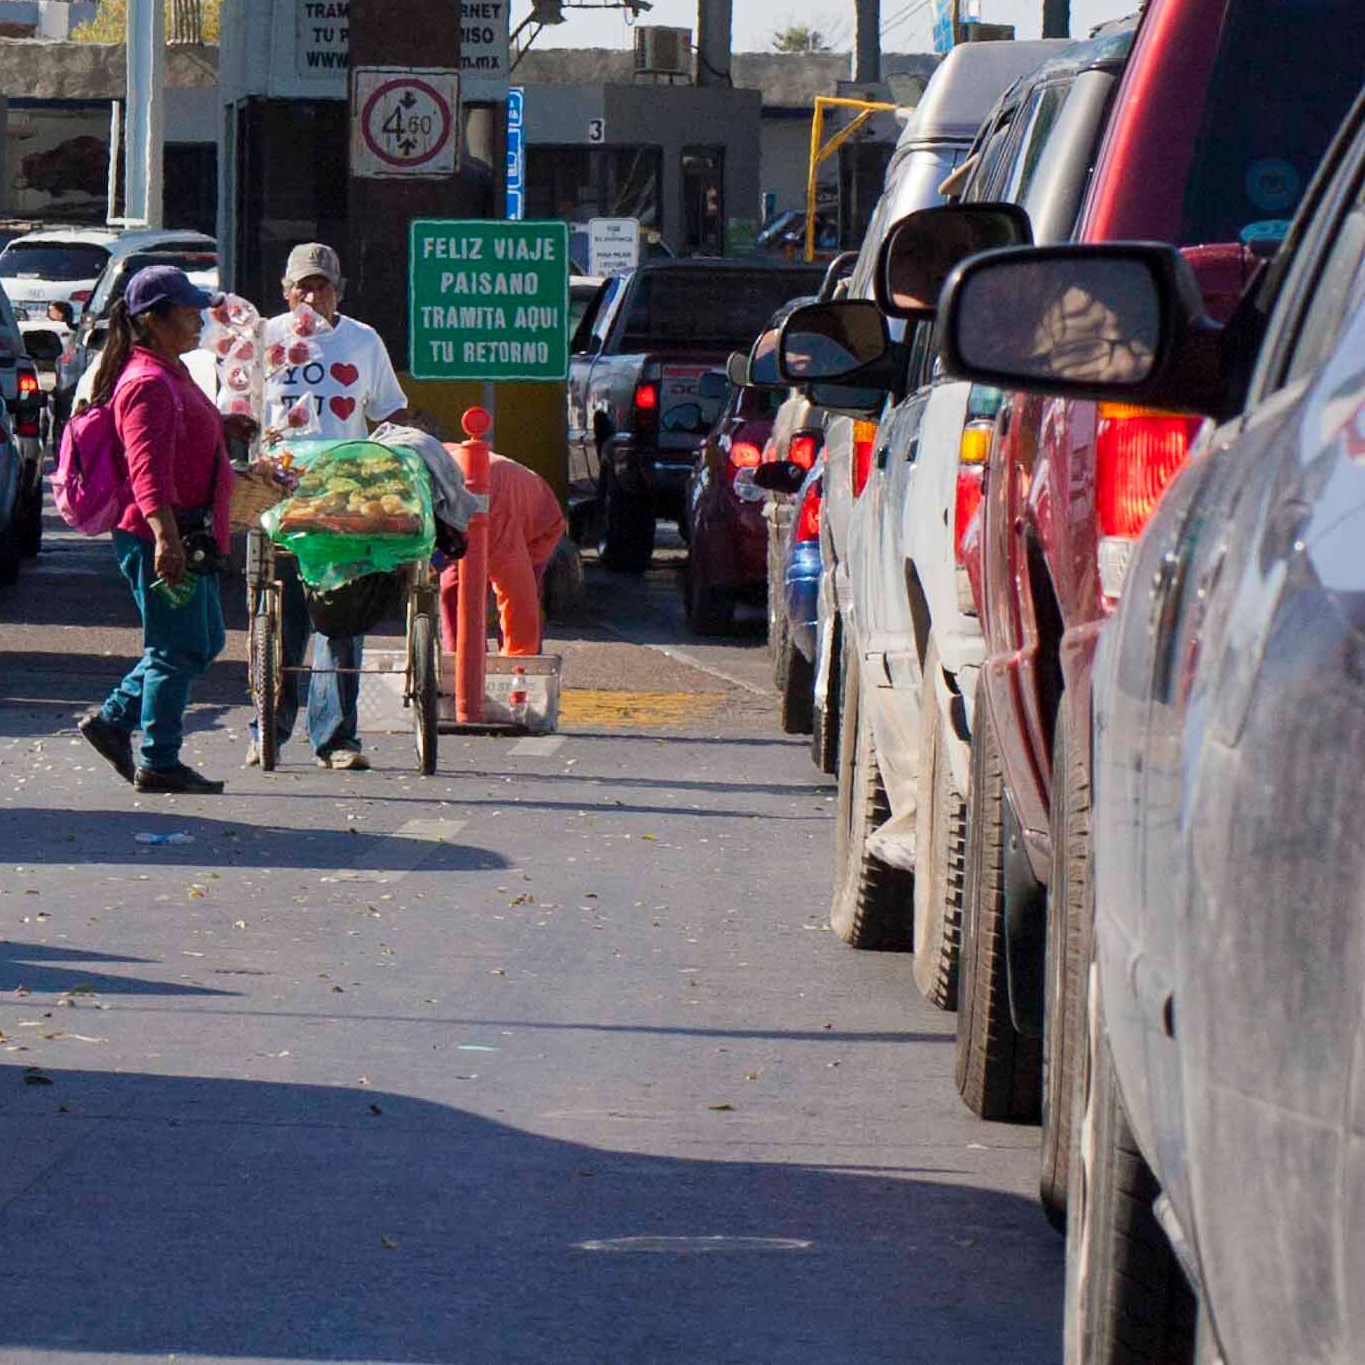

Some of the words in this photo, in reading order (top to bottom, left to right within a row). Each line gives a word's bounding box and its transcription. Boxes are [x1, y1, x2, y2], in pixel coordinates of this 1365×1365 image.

[305, 2, 349, 19] TRAM
[460, 3, 501, 19] RNET
[312, 27, 334, 43] TU
[589, 119, 603, 141] 3
[423, 237, 483, 259] FELIZ
[493, 238, 556, 260] VIAJE
[440, 272, 539, 295] PAISANO
[421, 306, 506, 329] TRAMITA
[514, 306, 558, 332] AQUI
[429, 340, 453, 363] TU
[463, 341, 549, 364] RETORNO
[282, 361, 325, 385] YO
